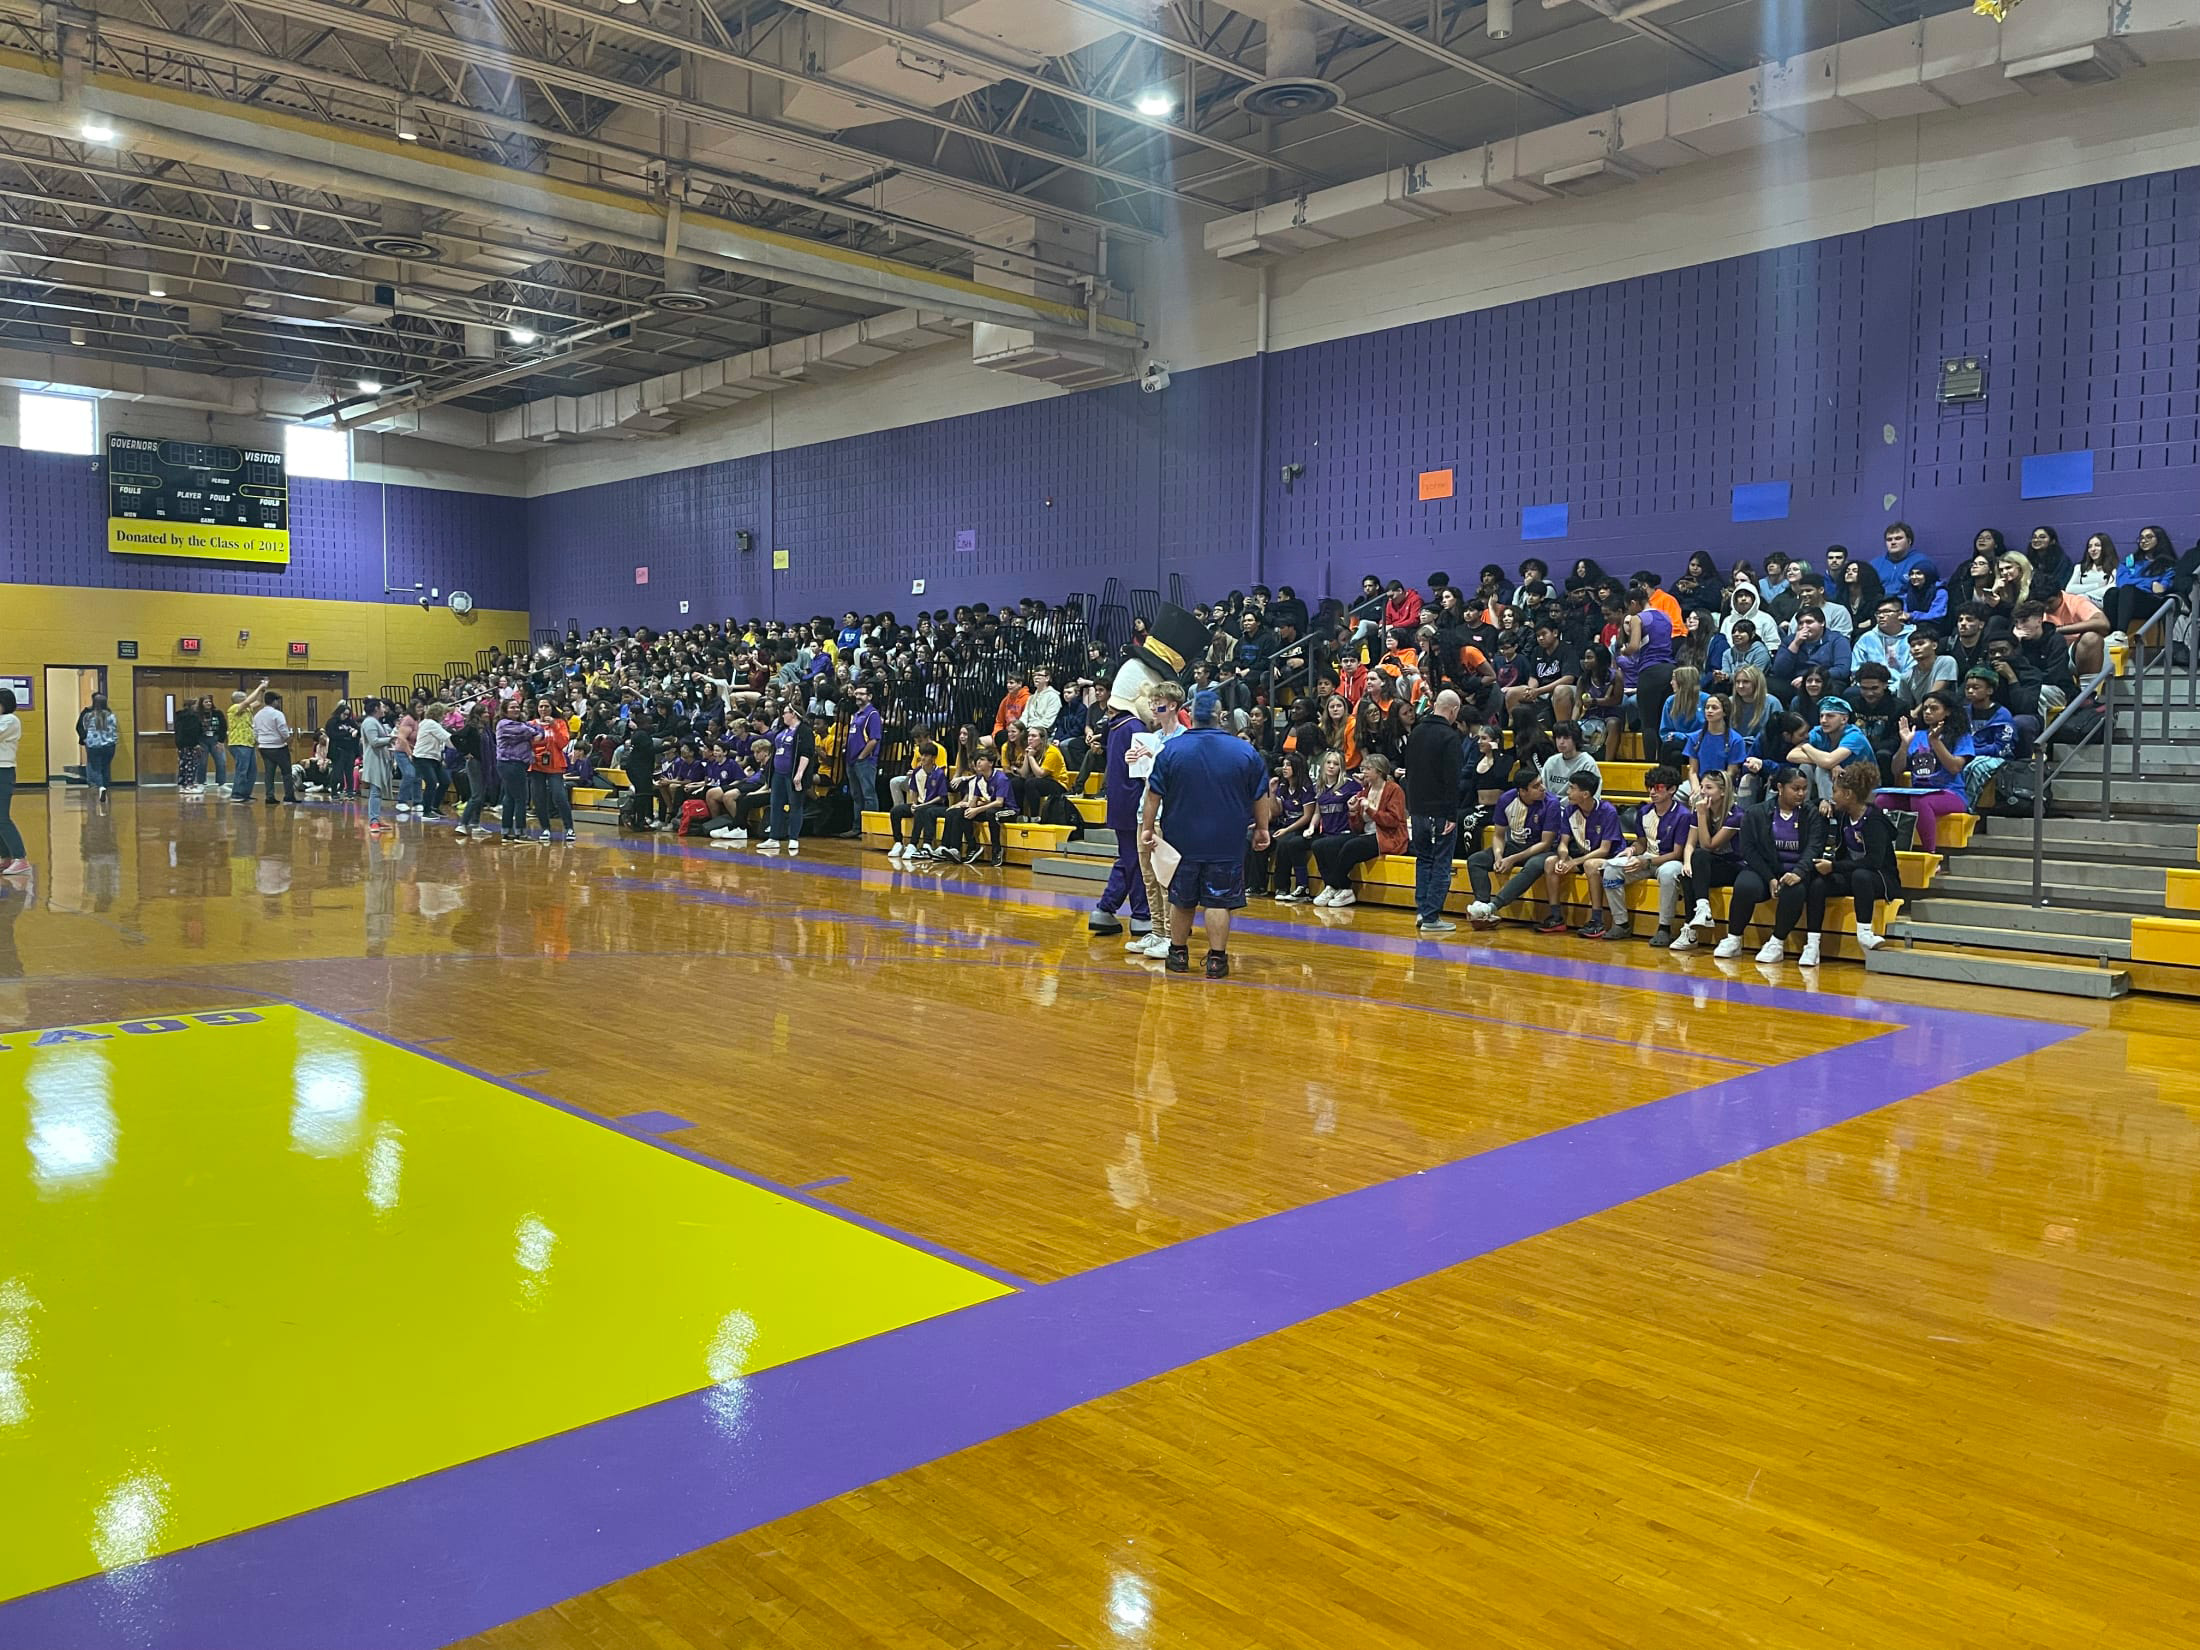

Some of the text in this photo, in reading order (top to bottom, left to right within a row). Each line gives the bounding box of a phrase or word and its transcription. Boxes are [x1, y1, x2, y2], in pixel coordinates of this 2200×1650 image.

[111, 438, 158, 451] GOVERNORS
[244, 451, 281, 464] VISITOR
[119, 486, 141, 494] FOULS
[177, 491, 231, 502] PLAYER FOULS
[259, 498, 280, 507] FOULS
[116, 530, 285, 552] Donated by the Class of 2012
[0, 1011, 266, 1050] GOV
